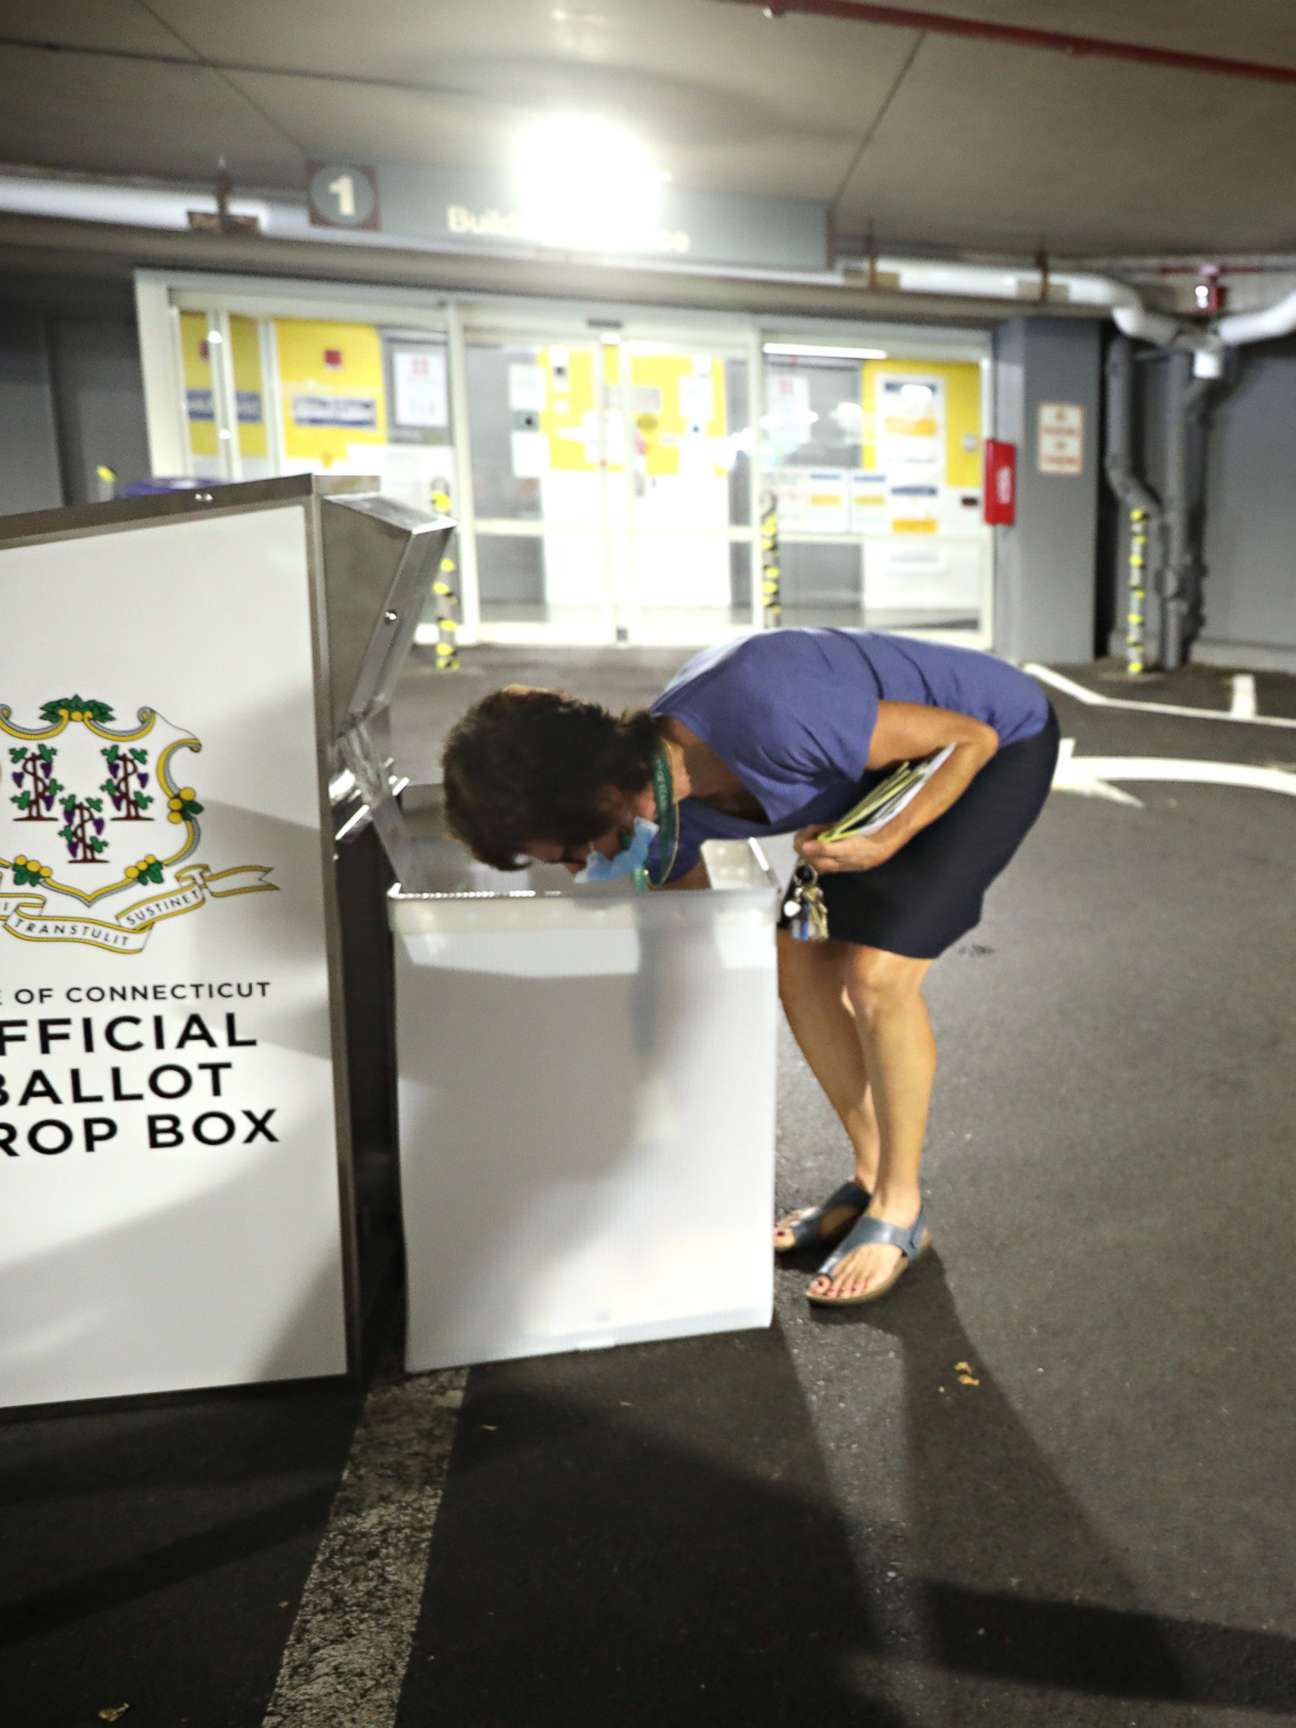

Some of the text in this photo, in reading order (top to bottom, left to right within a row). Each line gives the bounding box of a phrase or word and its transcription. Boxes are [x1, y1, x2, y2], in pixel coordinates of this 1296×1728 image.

[329, 177, 355, 215] 1
[126, 890, 199, 926] SUSTINET
[14, 918, 129, 946] TRANSTULIT
[14, 988, 53, 1005] OF
[66, 982, 271, 1003] CONNECTICUT
[0, 1012, 258, 1056] FFICIAL
[147, 1108, 280, 1149] BOX
